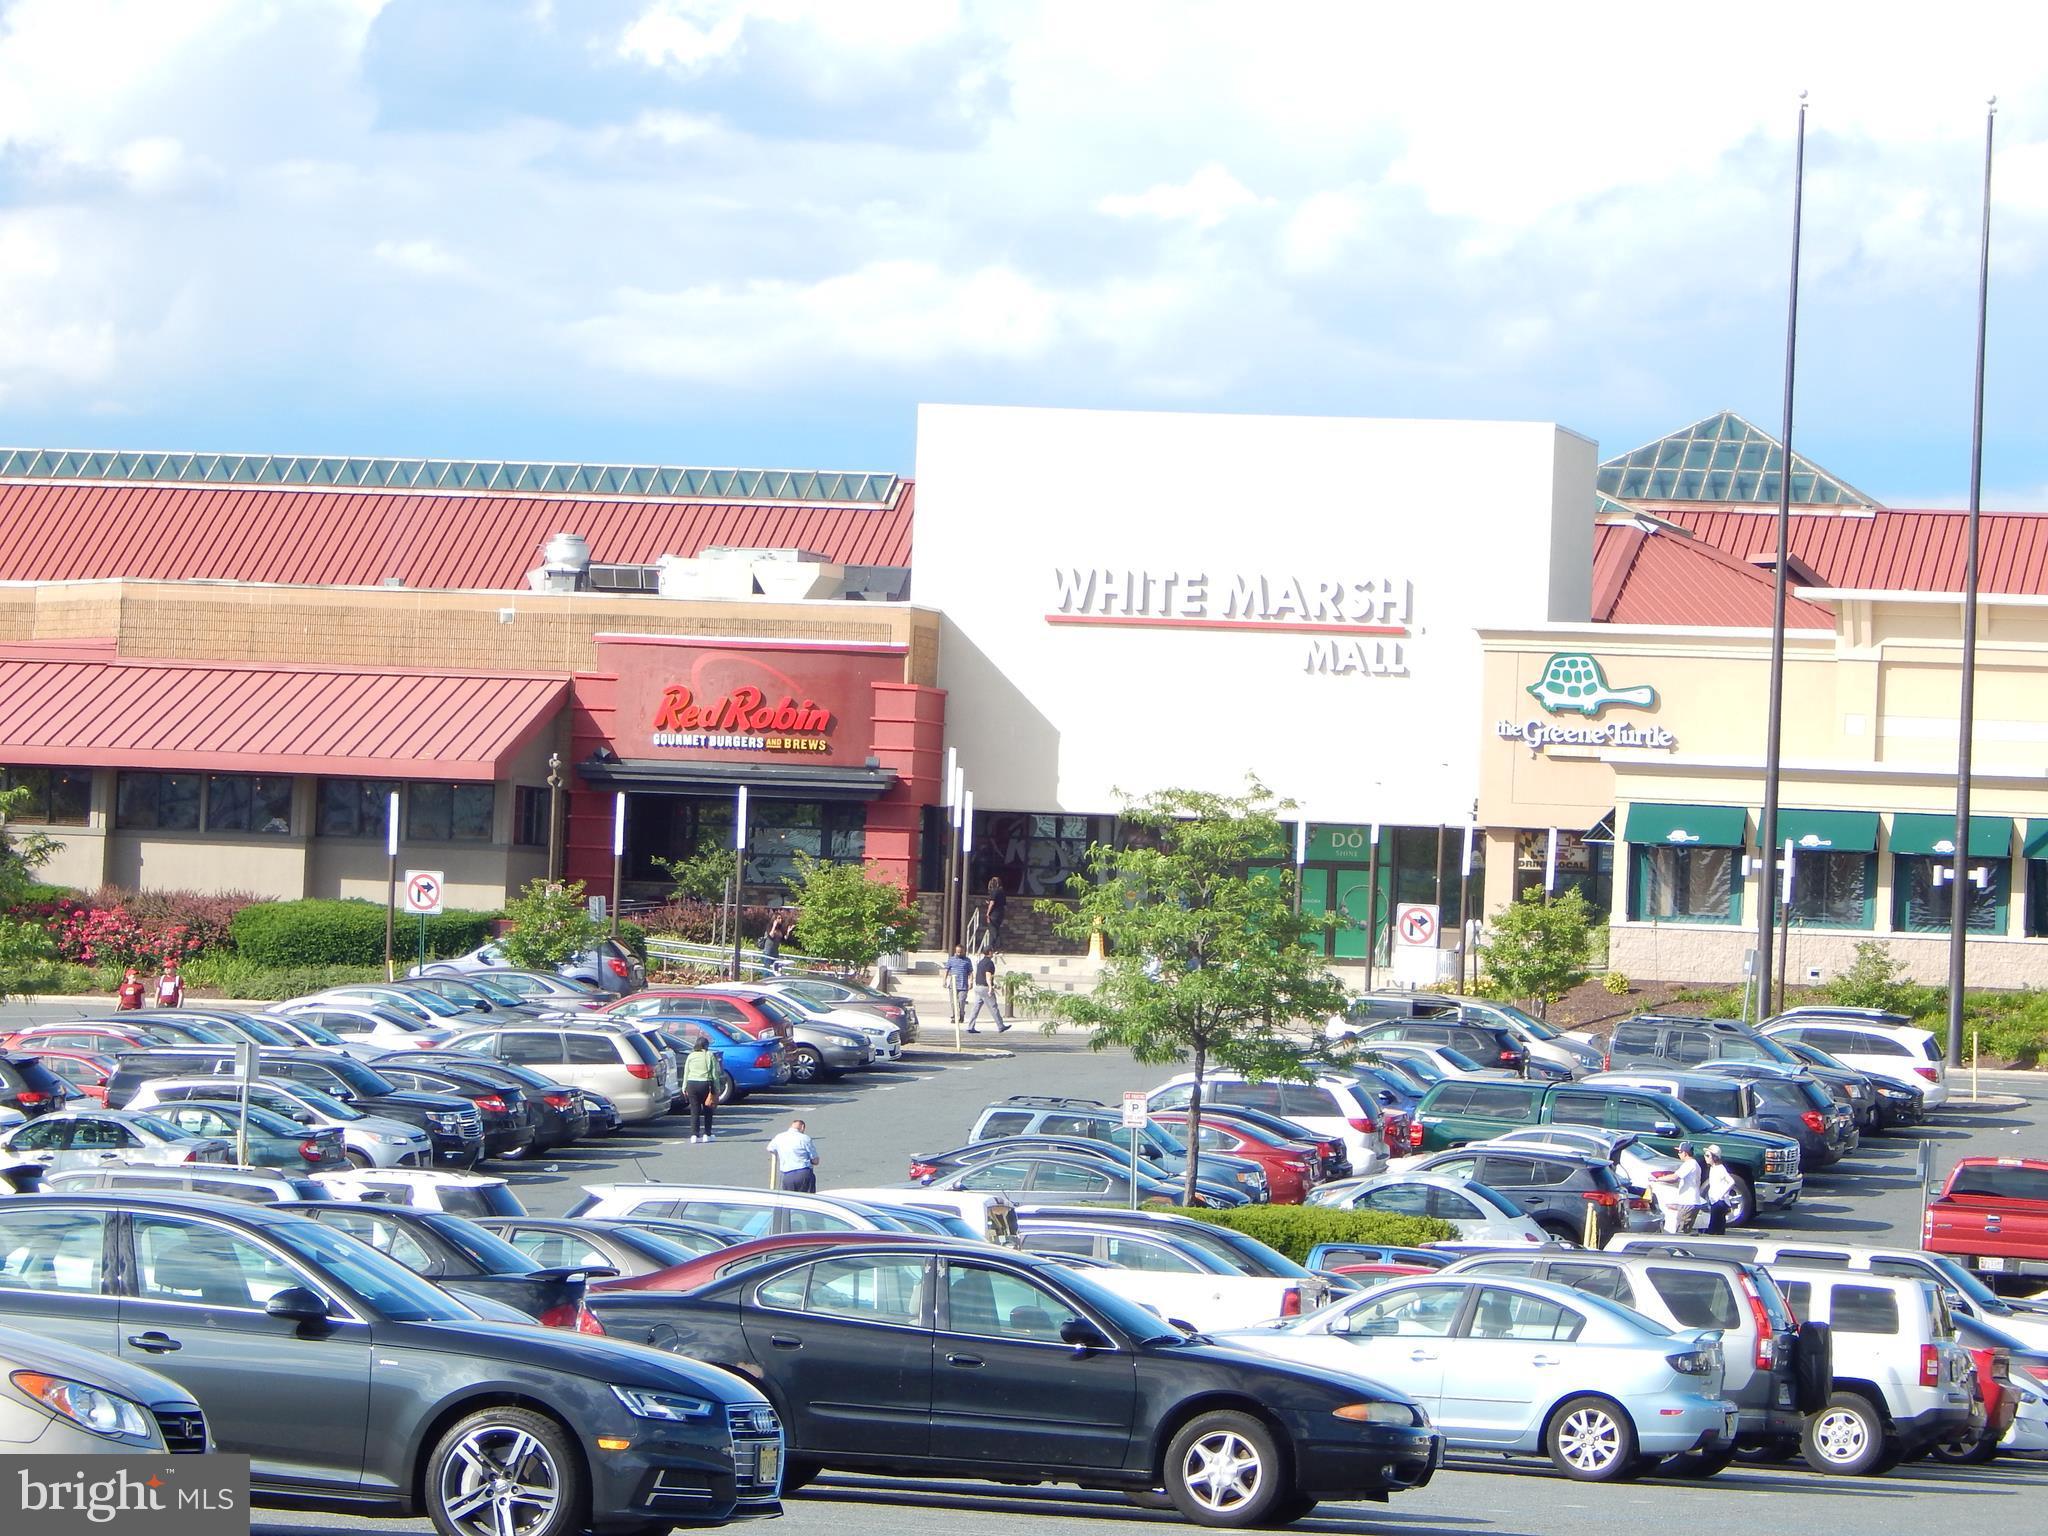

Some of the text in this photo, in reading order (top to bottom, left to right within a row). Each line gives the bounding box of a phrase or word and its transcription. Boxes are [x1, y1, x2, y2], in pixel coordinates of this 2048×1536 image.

[1053, 568, 1414, 625] WHITE MARSH
[1303, 640, 1410, 678] MALL
[653, 684, 832, 733] Red Robin
[653, 733, 826, 751] GOURMET BURGERS AND BREWS
[1498, 720, 1673, 748] the Greene Turtle
[1519, 859, 1586, 870] DRIN OCAL
